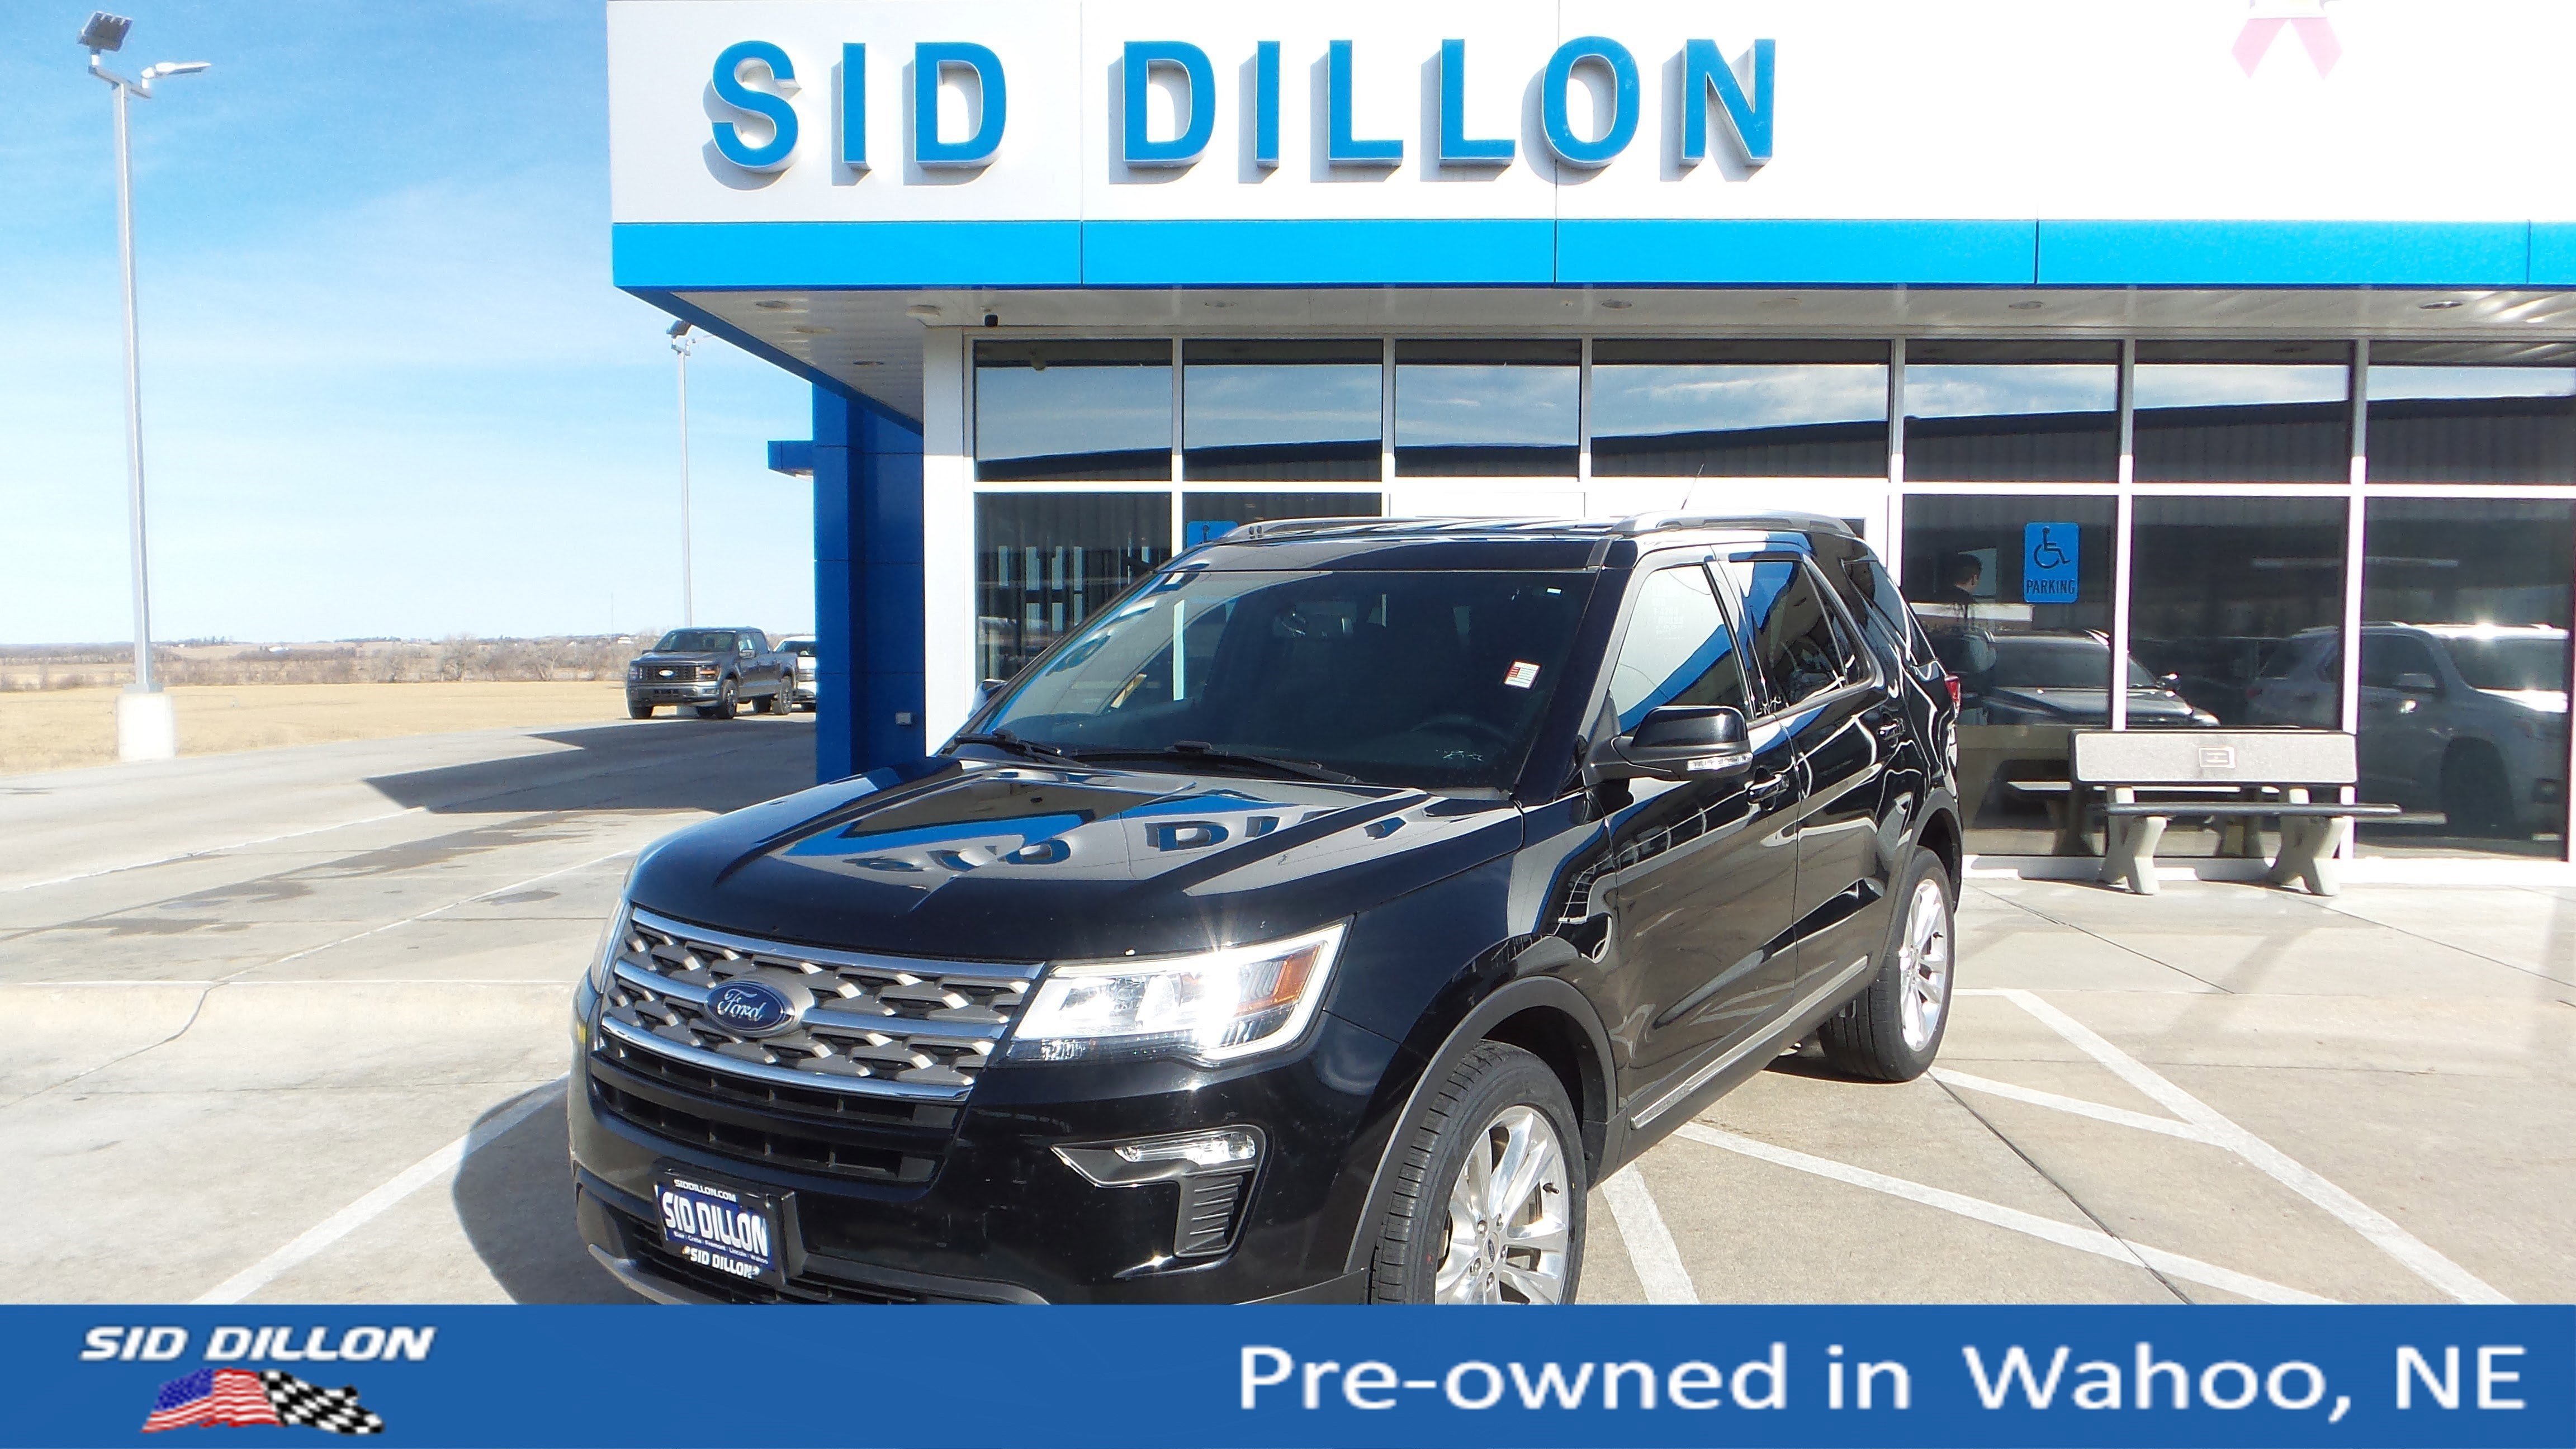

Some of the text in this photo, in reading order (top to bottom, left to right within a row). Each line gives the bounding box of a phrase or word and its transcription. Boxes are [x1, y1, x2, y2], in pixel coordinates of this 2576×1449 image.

[712, 36, 1775, 168] SID DILLON
[2026, 579, 2076, 594] PARKING
[717, 988, 767, 1021] Ford
[673, 1179, 736, 1202] SIDDILLON.COM
[662, 1192, 768, 1257] SID DILLON
[690, 1248, 752, 1279] SID DILLON
